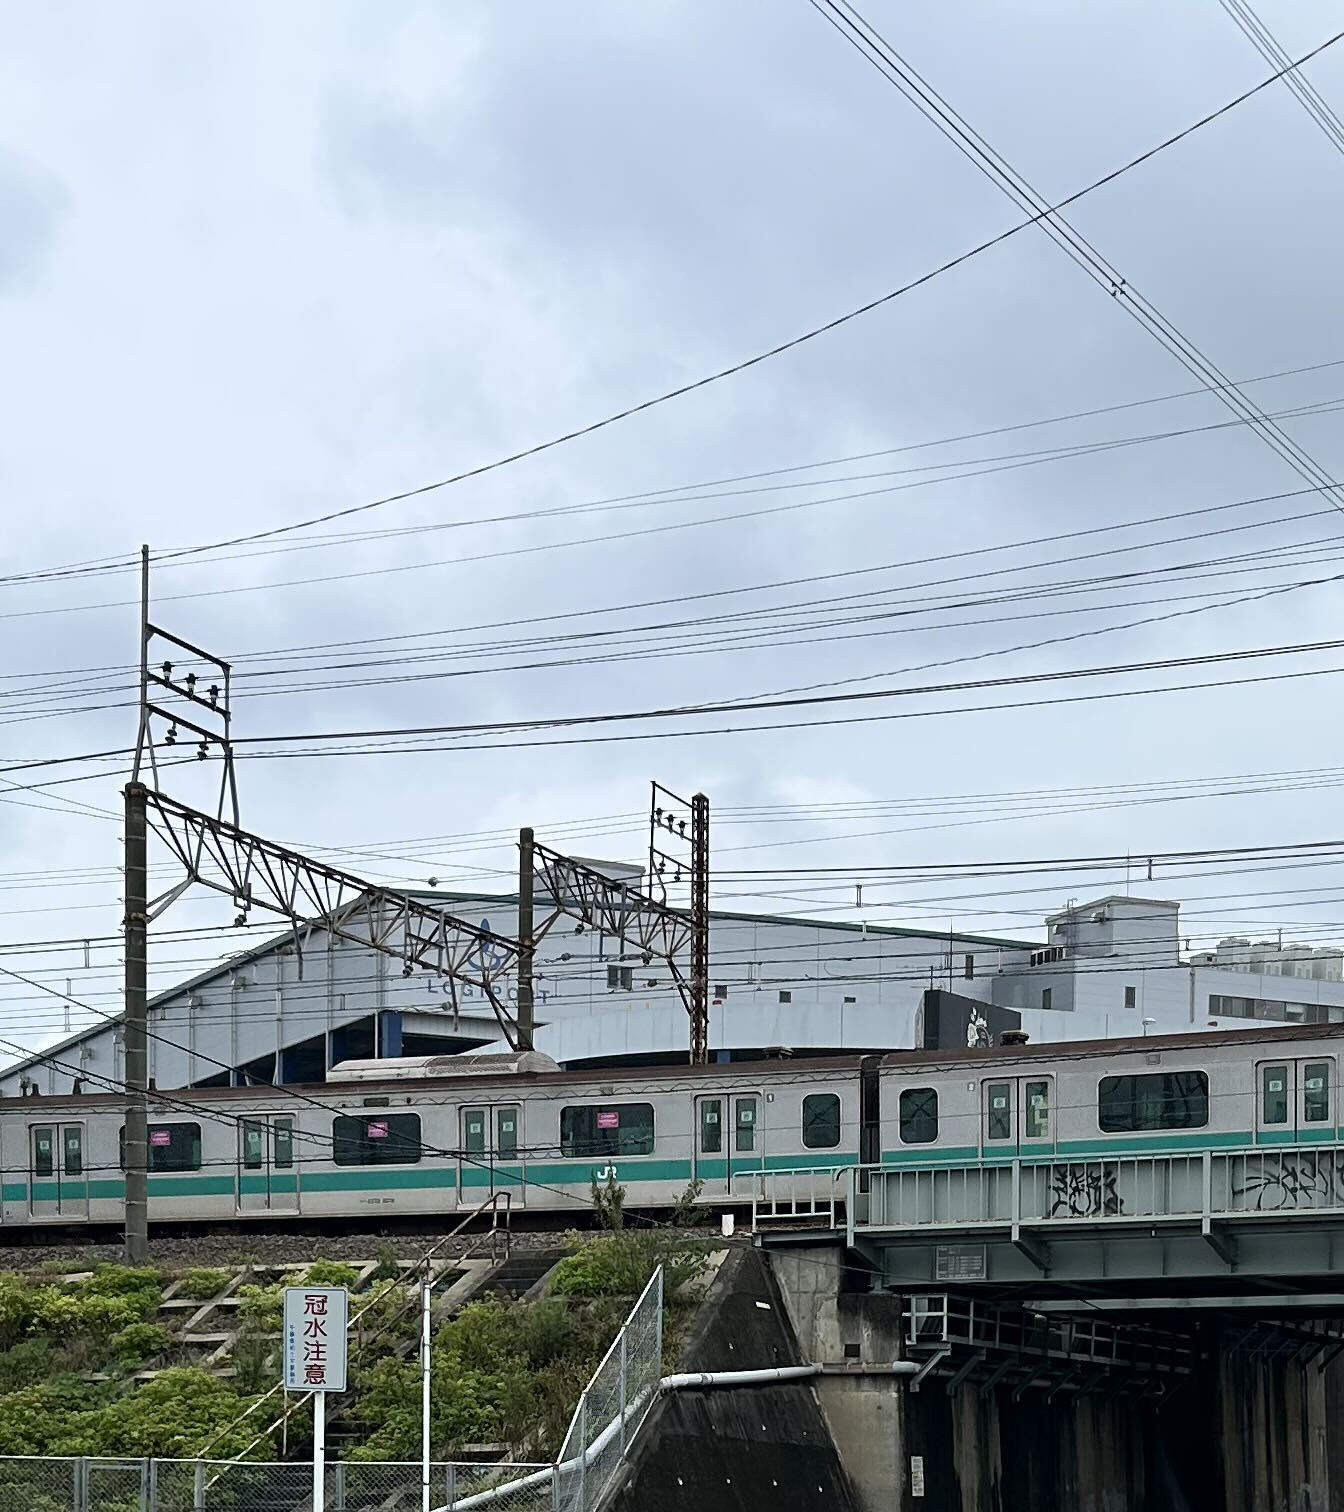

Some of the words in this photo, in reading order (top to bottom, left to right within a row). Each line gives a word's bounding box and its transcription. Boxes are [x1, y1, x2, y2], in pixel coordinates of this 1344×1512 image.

[427, 979, 551, 1004] LOGIPOT
[303, 1294, 328, 1385] 冠水注意
